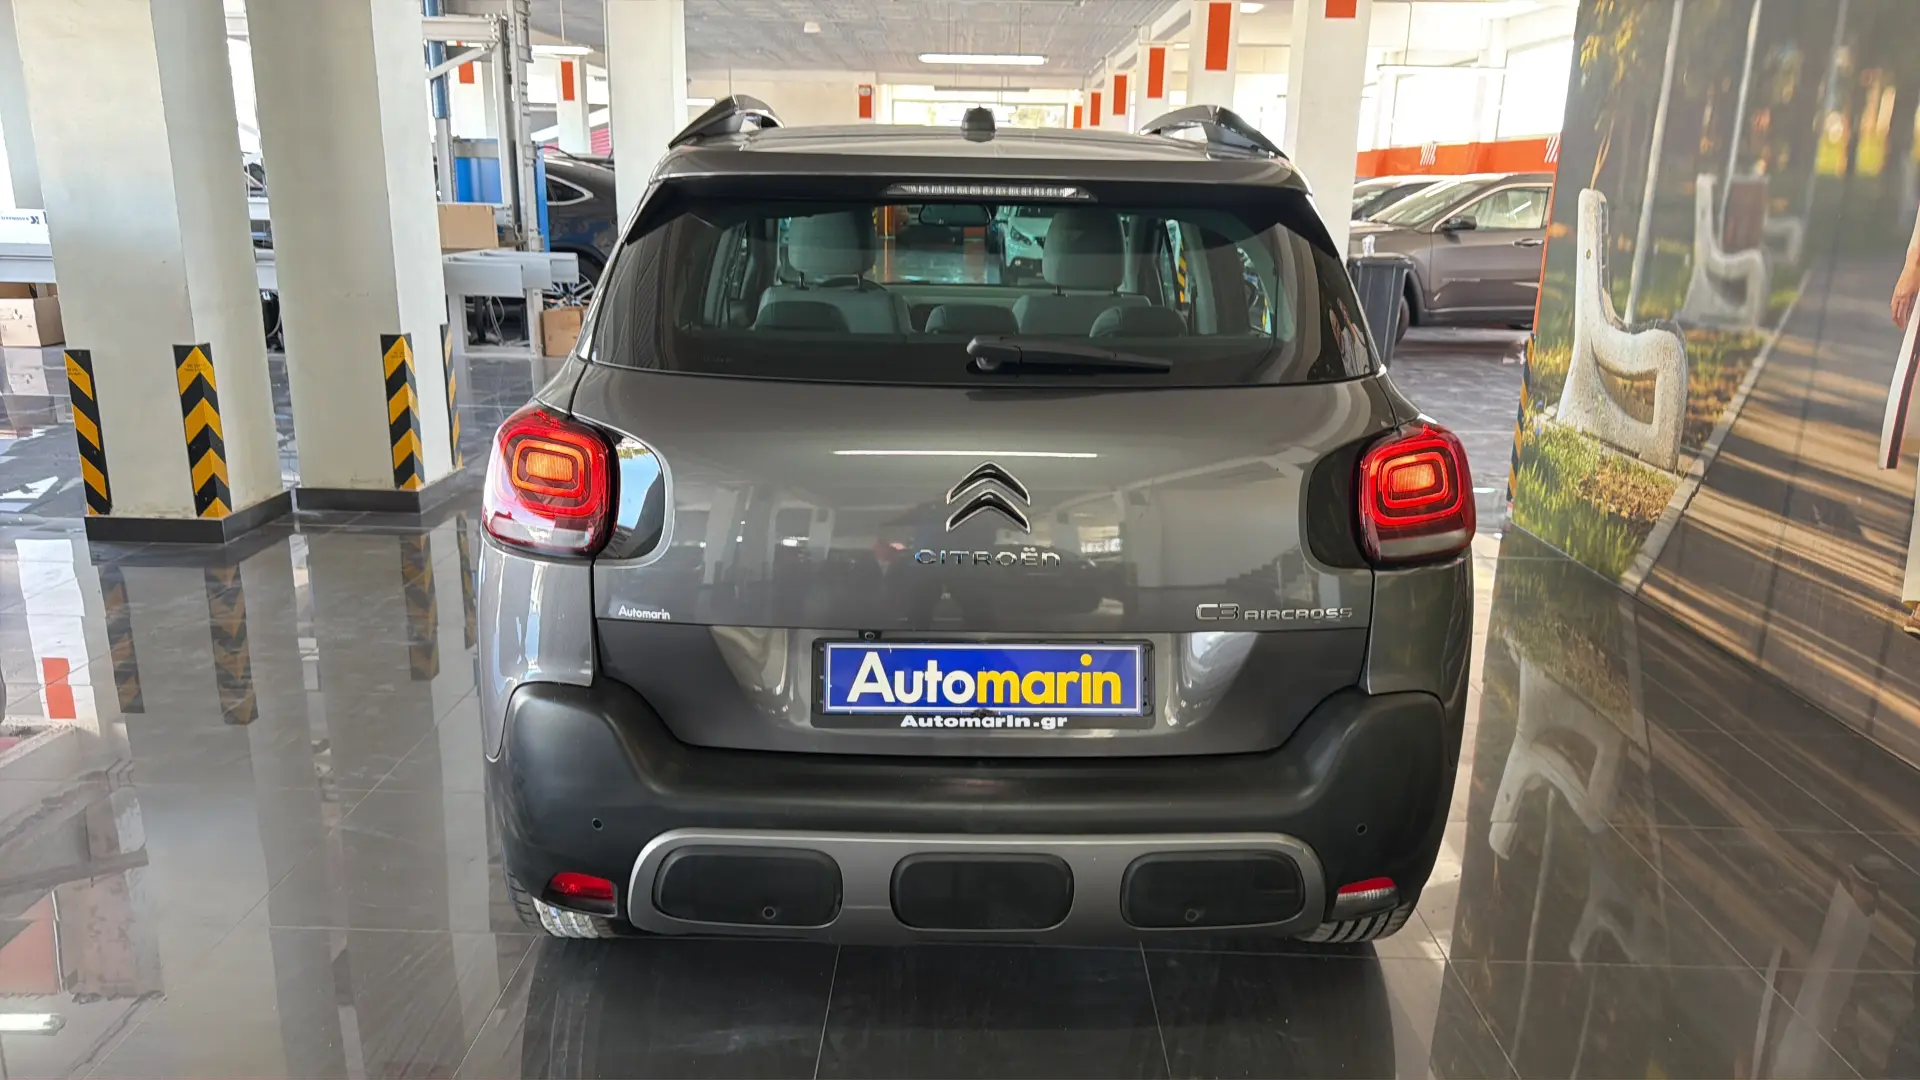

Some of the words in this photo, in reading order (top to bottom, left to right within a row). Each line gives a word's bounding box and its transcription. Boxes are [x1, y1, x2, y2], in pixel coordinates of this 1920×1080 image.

[618, 604, 671, 620] Automarin
[1196, 603, 1240, 620] C3
[1244, 608, 1353, 620] AIRCROSS
[846, 651, 1123, 705] Automarin
[900, 714, 1068, 730] Automarin.gr
